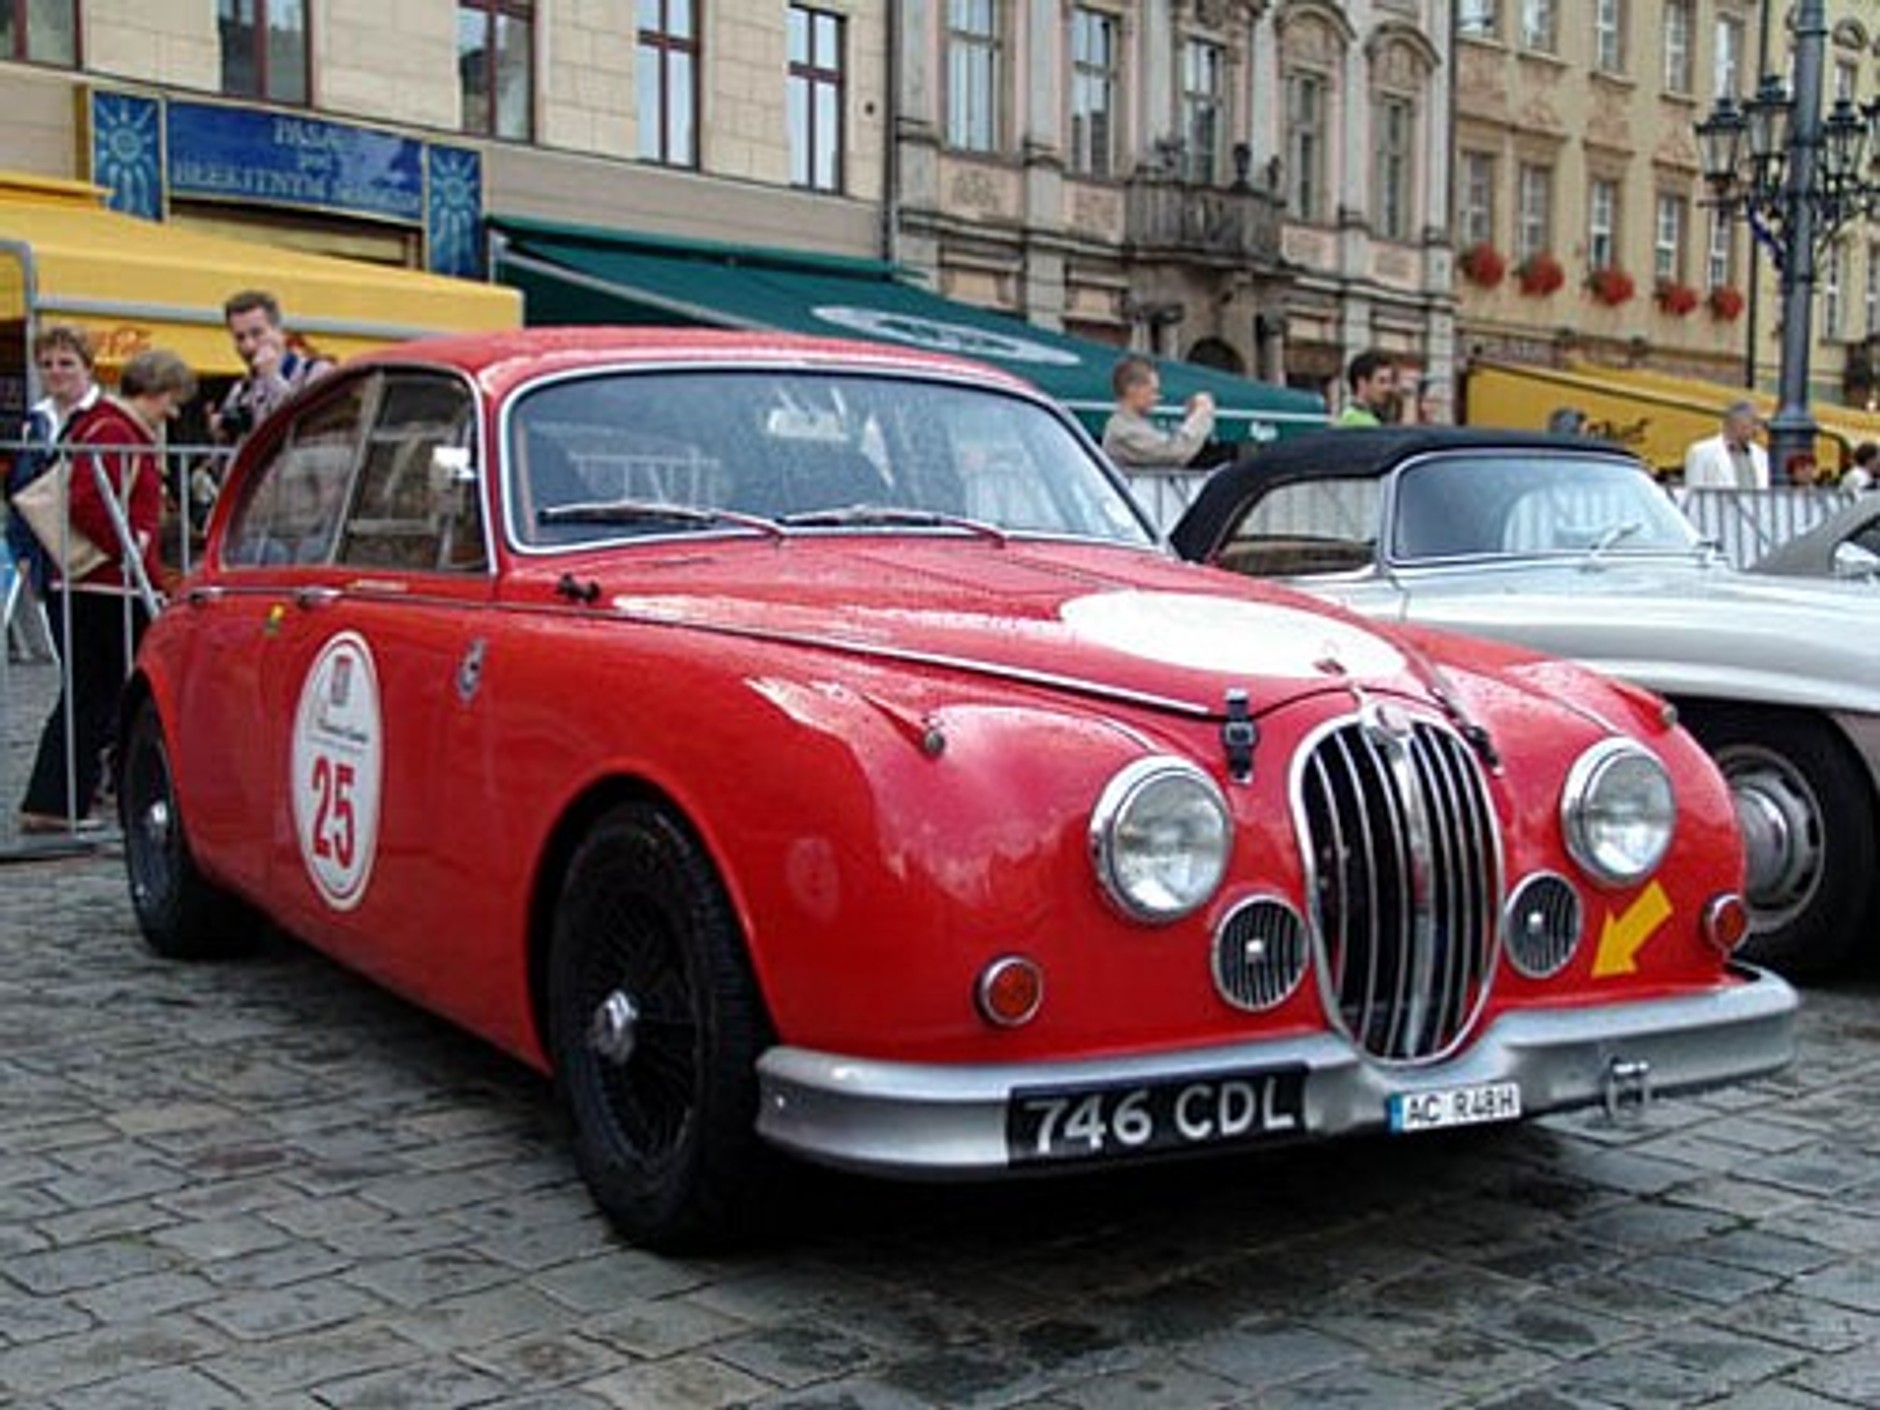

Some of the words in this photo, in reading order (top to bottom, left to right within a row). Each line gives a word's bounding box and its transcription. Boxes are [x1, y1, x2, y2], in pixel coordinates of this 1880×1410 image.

[312, 755, 355, 868] 25
[1024, 1088, 1152, 1154] 746
[1174, 1075, 1295, 1139] CDL
